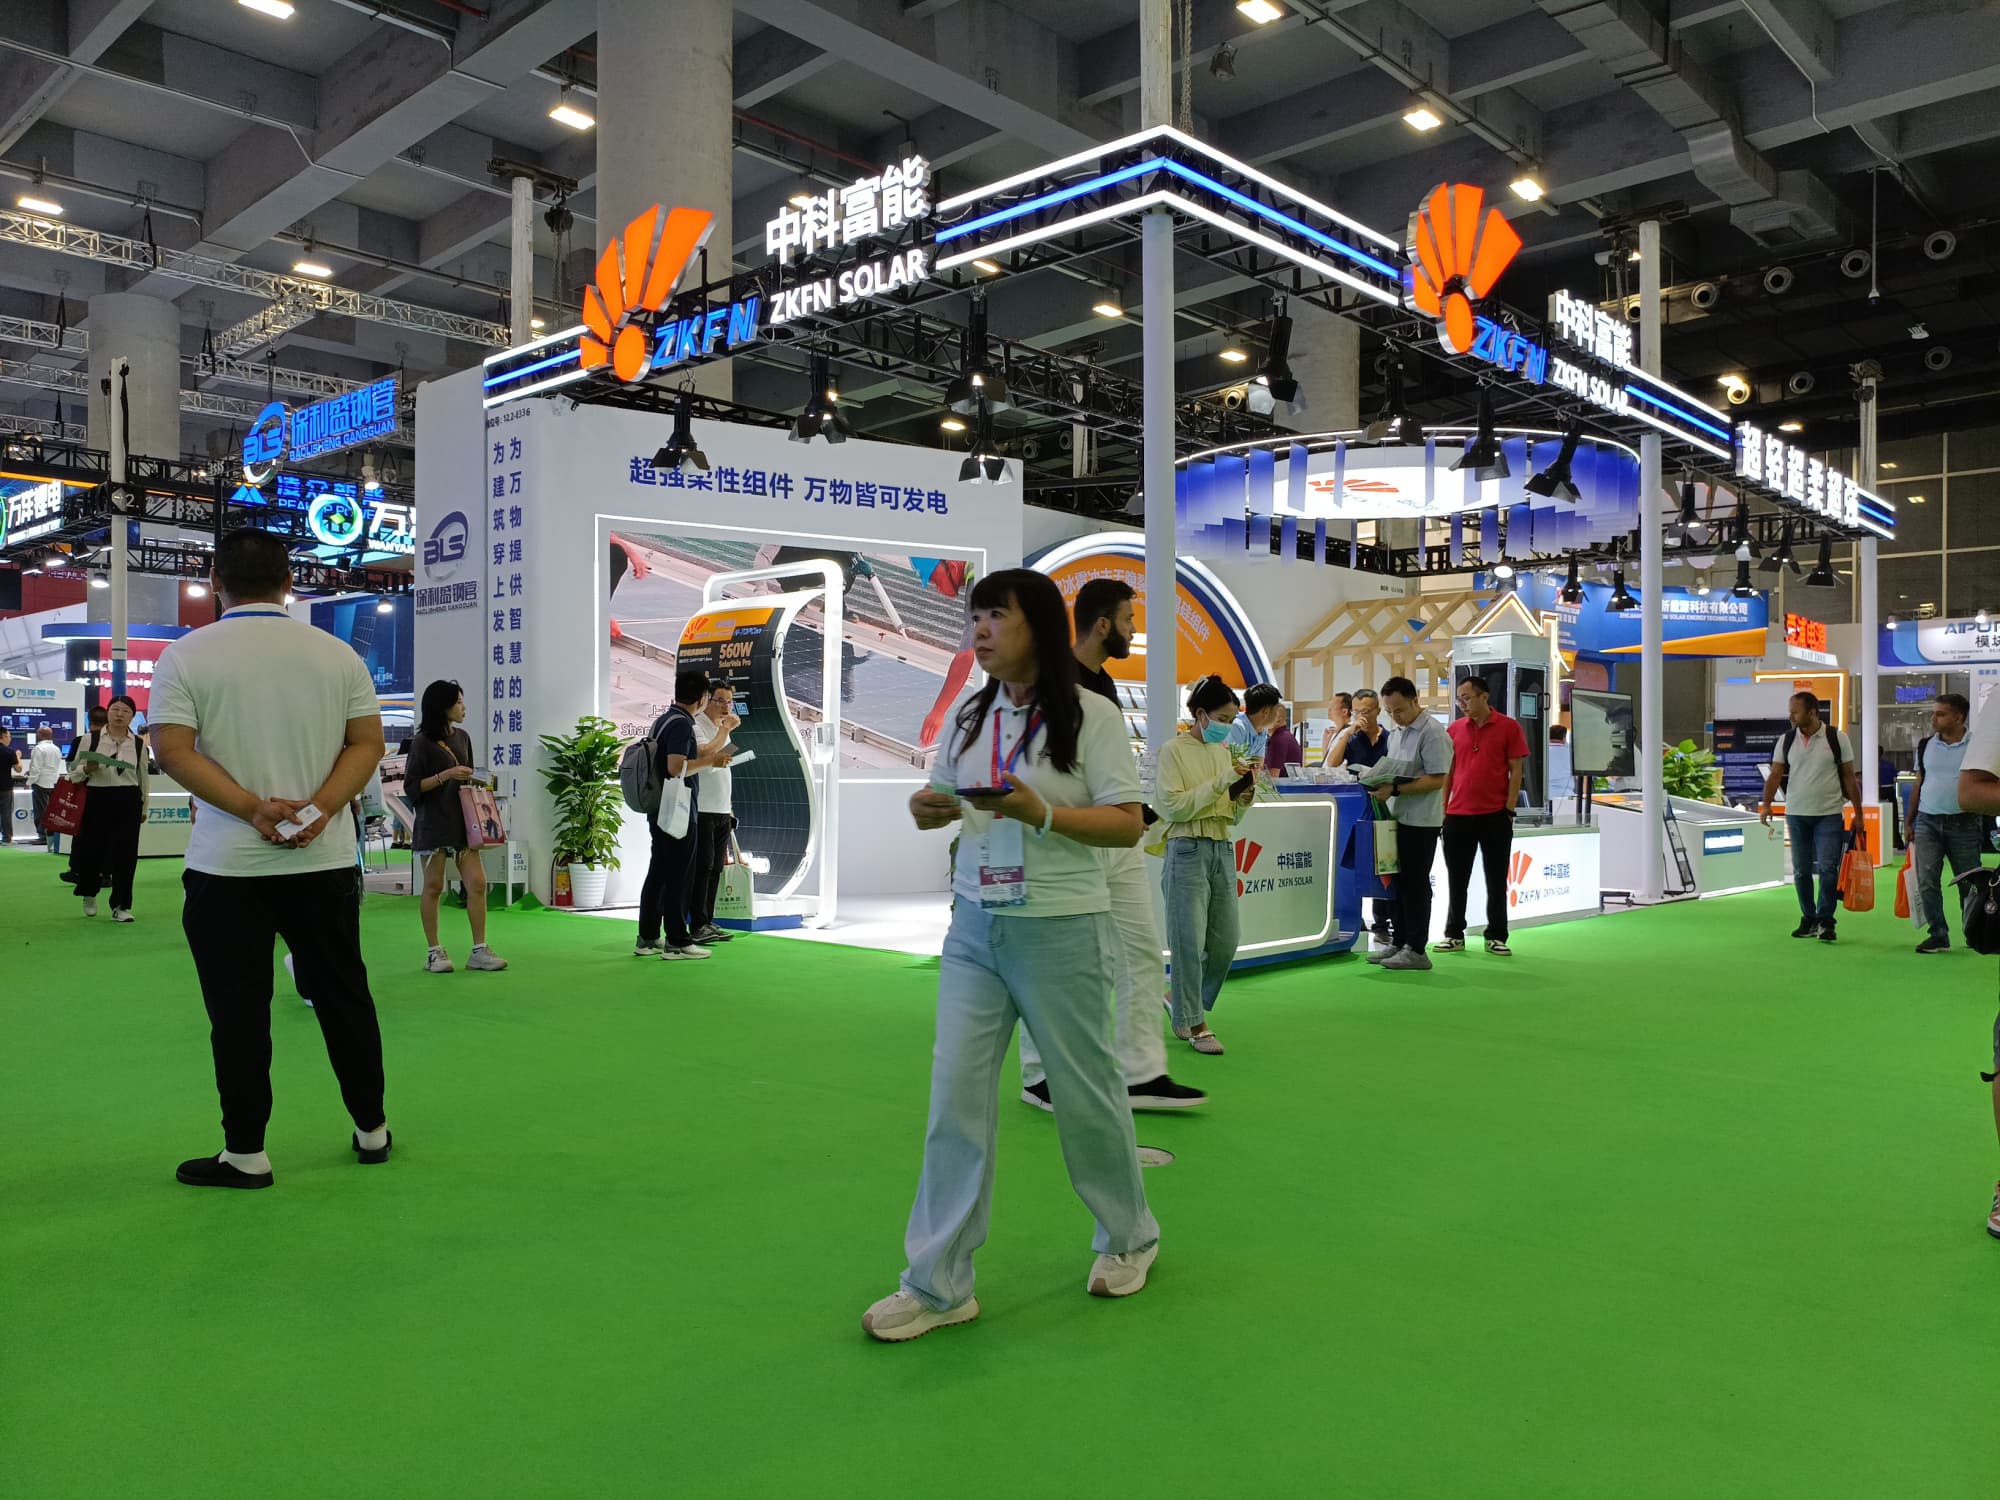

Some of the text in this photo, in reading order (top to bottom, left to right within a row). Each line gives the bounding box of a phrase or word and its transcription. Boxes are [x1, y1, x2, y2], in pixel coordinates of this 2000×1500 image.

[766, 154, 931, 265] 中科富能
[769, 248, 928, 325] ZKFN SOLAR
[651, 298, 759, 370] ZKFN
[1554, 288, 1633, 367] 中科富能
[1471, 315, 1547, 385] ZKFN
[1552, 357, 1629, 417] ZKFN SOLAR
[291, 379, 395, 448] 保利盛钢管
[343, 419, 395, 446] GANGGUAN
[803, 478, 949, 516] 万物皆可发电
[367, 538, 416, 555] WANYAN
[424, 534, 465, 566] BLS
[416, 580, 478, 609] 保利盛钢管
[492, 441, 505, 767] 为建筑穿上发电的外衣
[719, 641, 754, 660] 560W
[1277, 851, 1313, 871] 中科富能
[1245, 878, 1275, 894] ZKFN
[1278, 875, 1313, 888] ZKFN SOLAR
[1518, 889, 1541, 904] ZKFN
